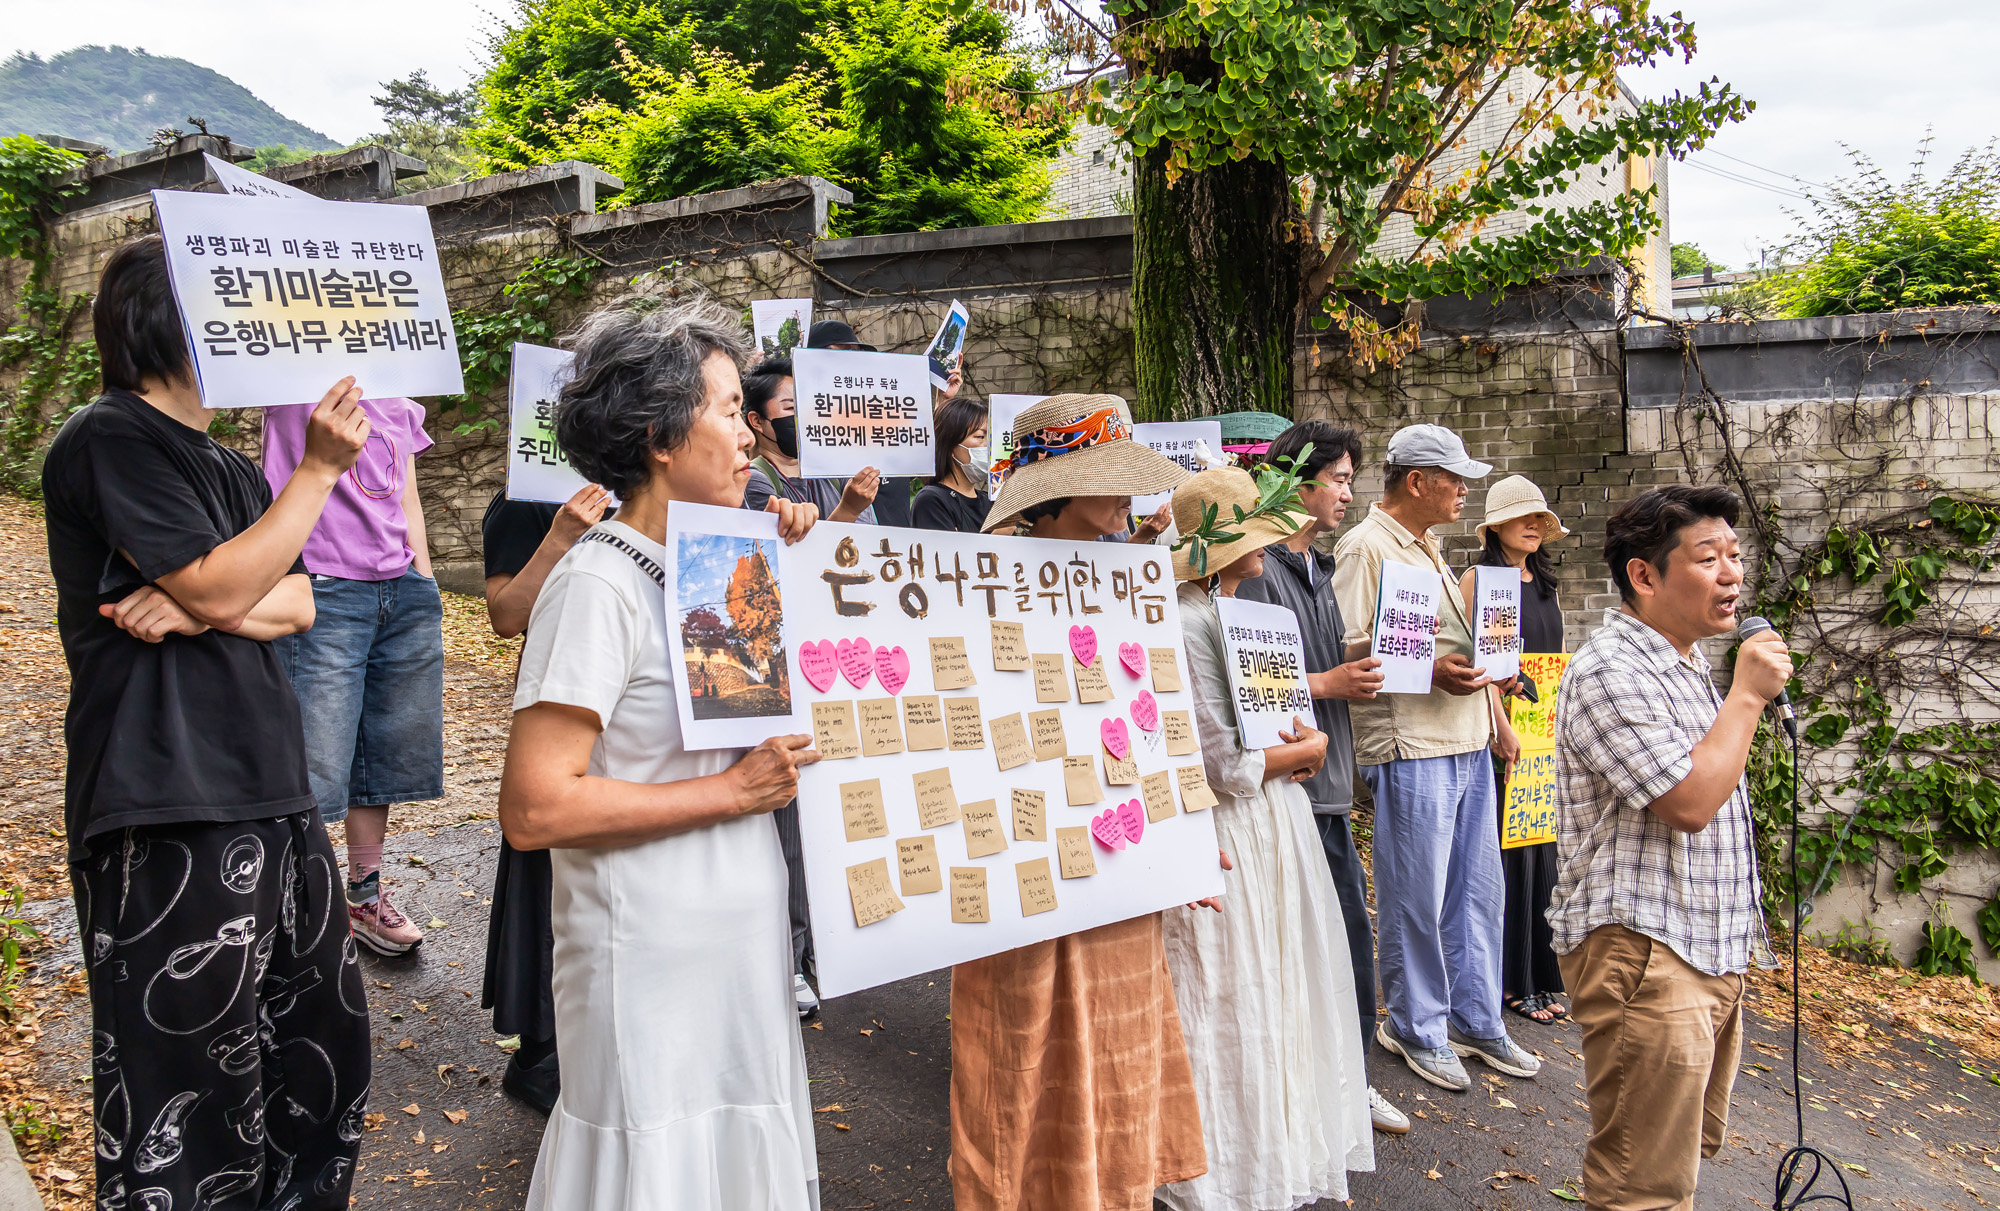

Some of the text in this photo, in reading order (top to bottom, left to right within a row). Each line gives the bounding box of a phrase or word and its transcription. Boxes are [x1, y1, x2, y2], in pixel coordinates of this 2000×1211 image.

[185, 234, 424, 261] 생명파괴 미술관 규탄한다
[210, 265, 420, 309] 환기미술관은
[203, 317, 448, 357] 은행나무 살려내라
[833, 376, 898, 391] 은행나무 독살
[814, 392, 918, 420] 환기미술관은
[806, 424, 930, 447] 책임있게 복원하라
[1165, 441, 1179, 451] 독살
[1112, 561, 1167, 624] 마음
[1396, 589, 1430, 607] 사유지 핑계 그만
[1491, 589, 1505, 601] 은행나무
[1382, 607, 1435, 635] 서울시는 은행나무를
[1483, 606, 1517, 628] 환기미술관은
[1228, 626, 1299, 646] 생명파괴 미술관 규탄한다
[1378, 634, 1434, 661] 보호수로 지정하라
[1479, 634, 1519, 655] 책임있게 복원하라
[1237, 647, 1300, 680] 환기미술관은
[1239, 686, 1311, 712] 은행나무 살려내라
